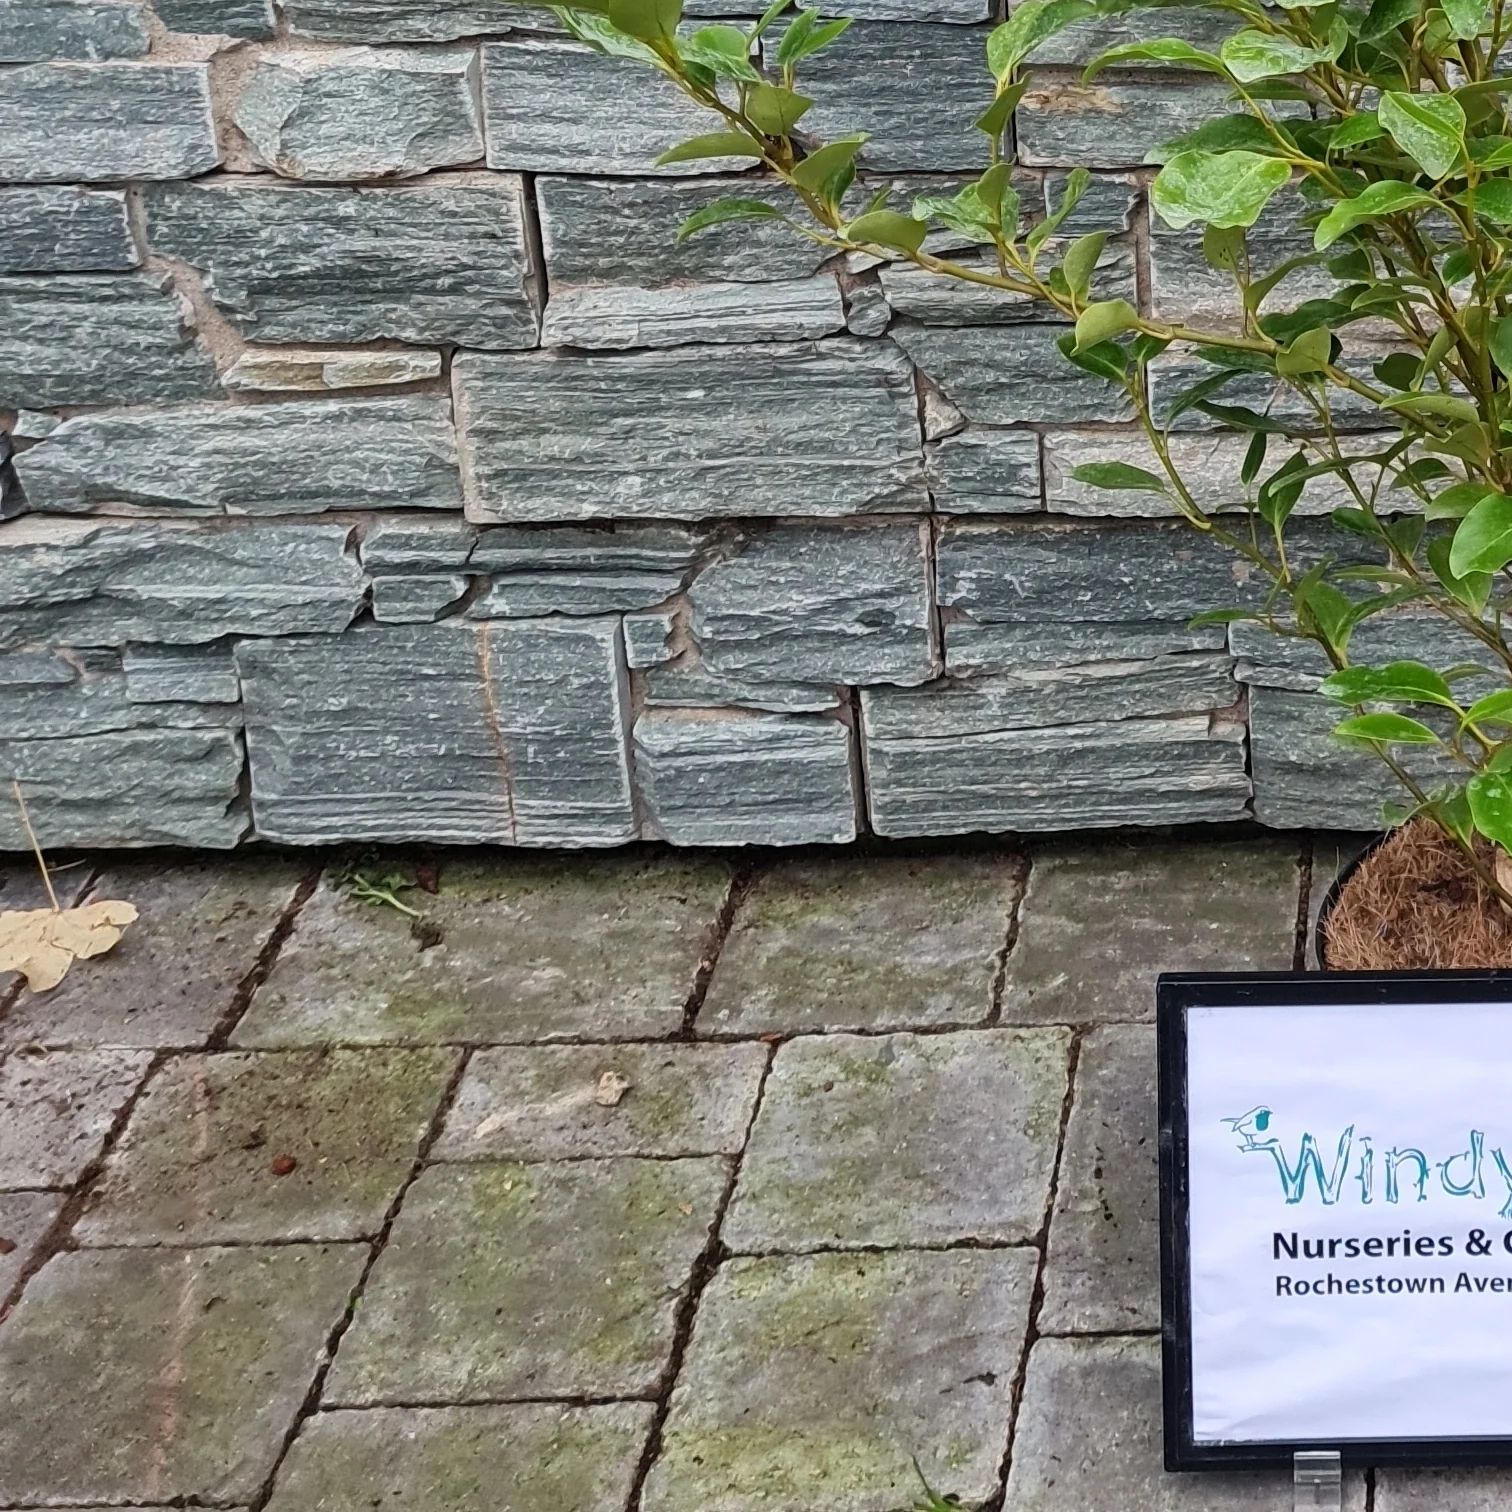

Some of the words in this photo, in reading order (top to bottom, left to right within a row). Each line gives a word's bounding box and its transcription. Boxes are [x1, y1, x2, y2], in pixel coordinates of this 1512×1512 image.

[1273, 1229, 1454, 1260] Nurseries
[1465, 1228, 1493, 1256] &
[1276, 1273, 1445, 1296] Rochestown
